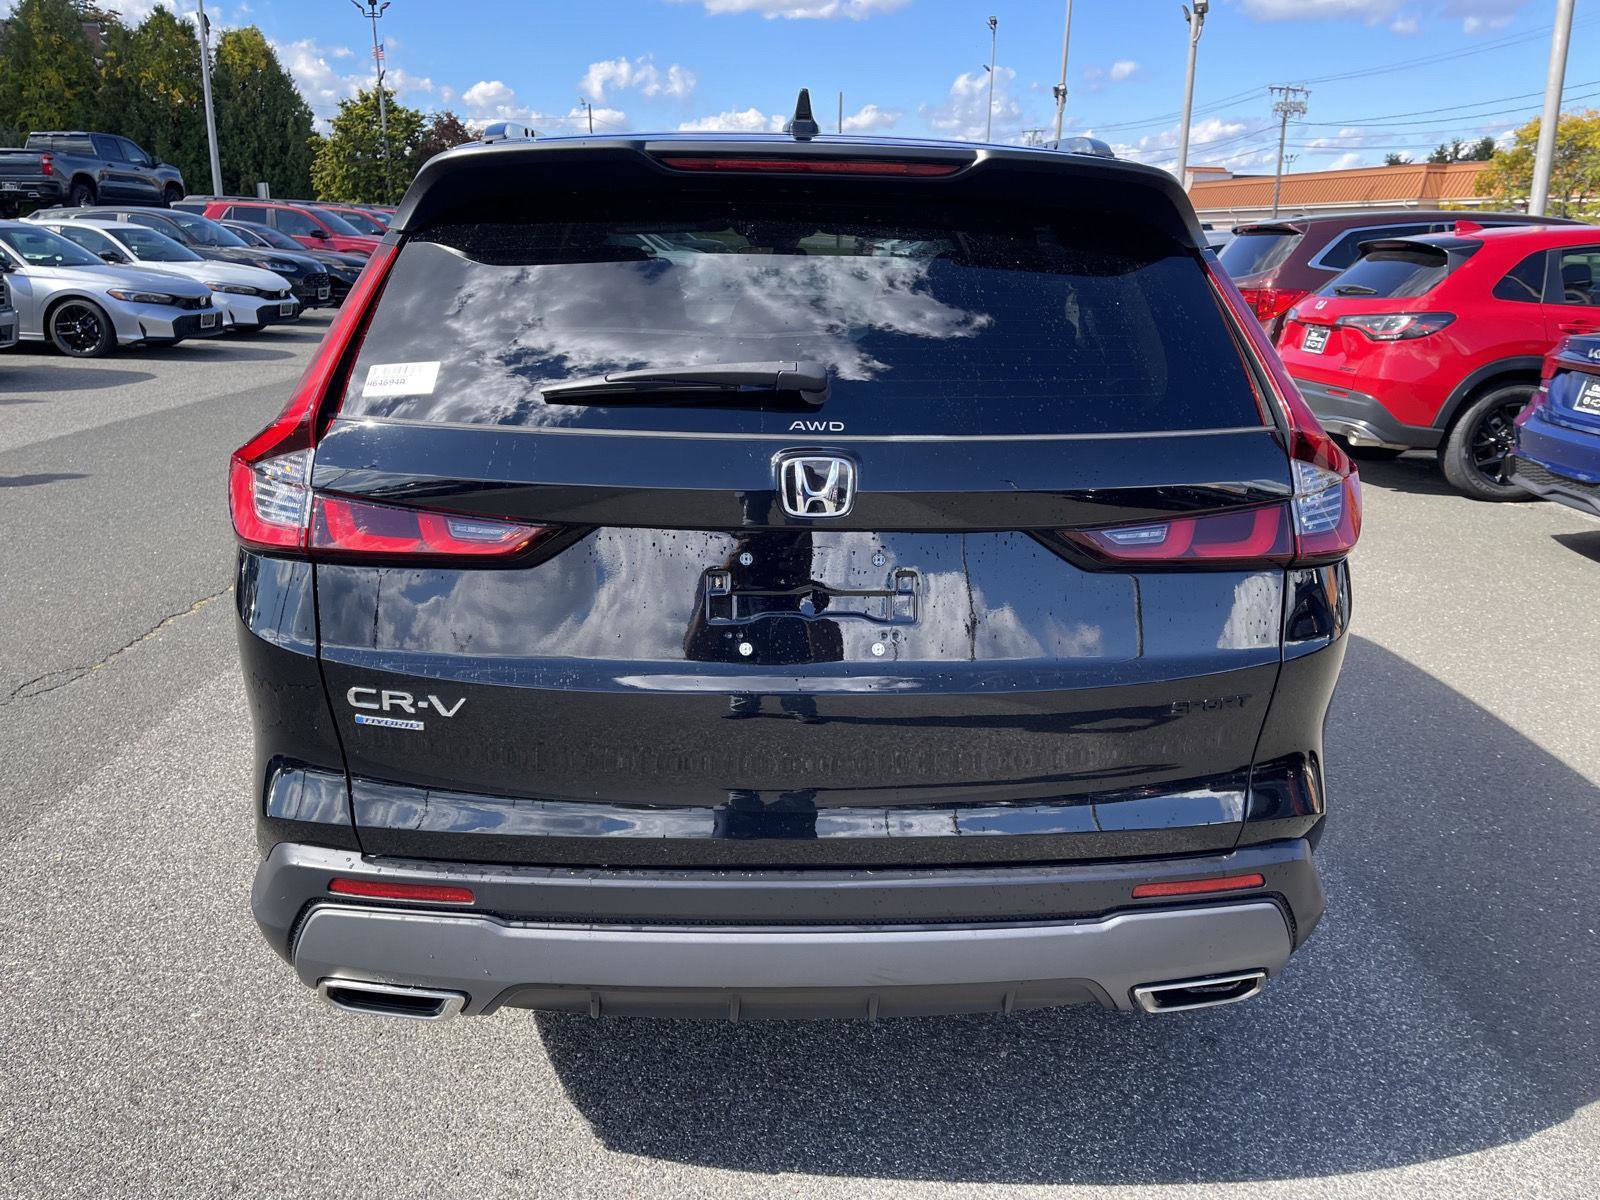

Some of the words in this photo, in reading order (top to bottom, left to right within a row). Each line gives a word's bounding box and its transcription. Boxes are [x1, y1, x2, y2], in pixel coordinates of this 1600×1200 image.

[789, 420, 845, 432] AWD
[346, 686, 467, 718] CR-V
[364, 717, 421, 730] HYBRID
